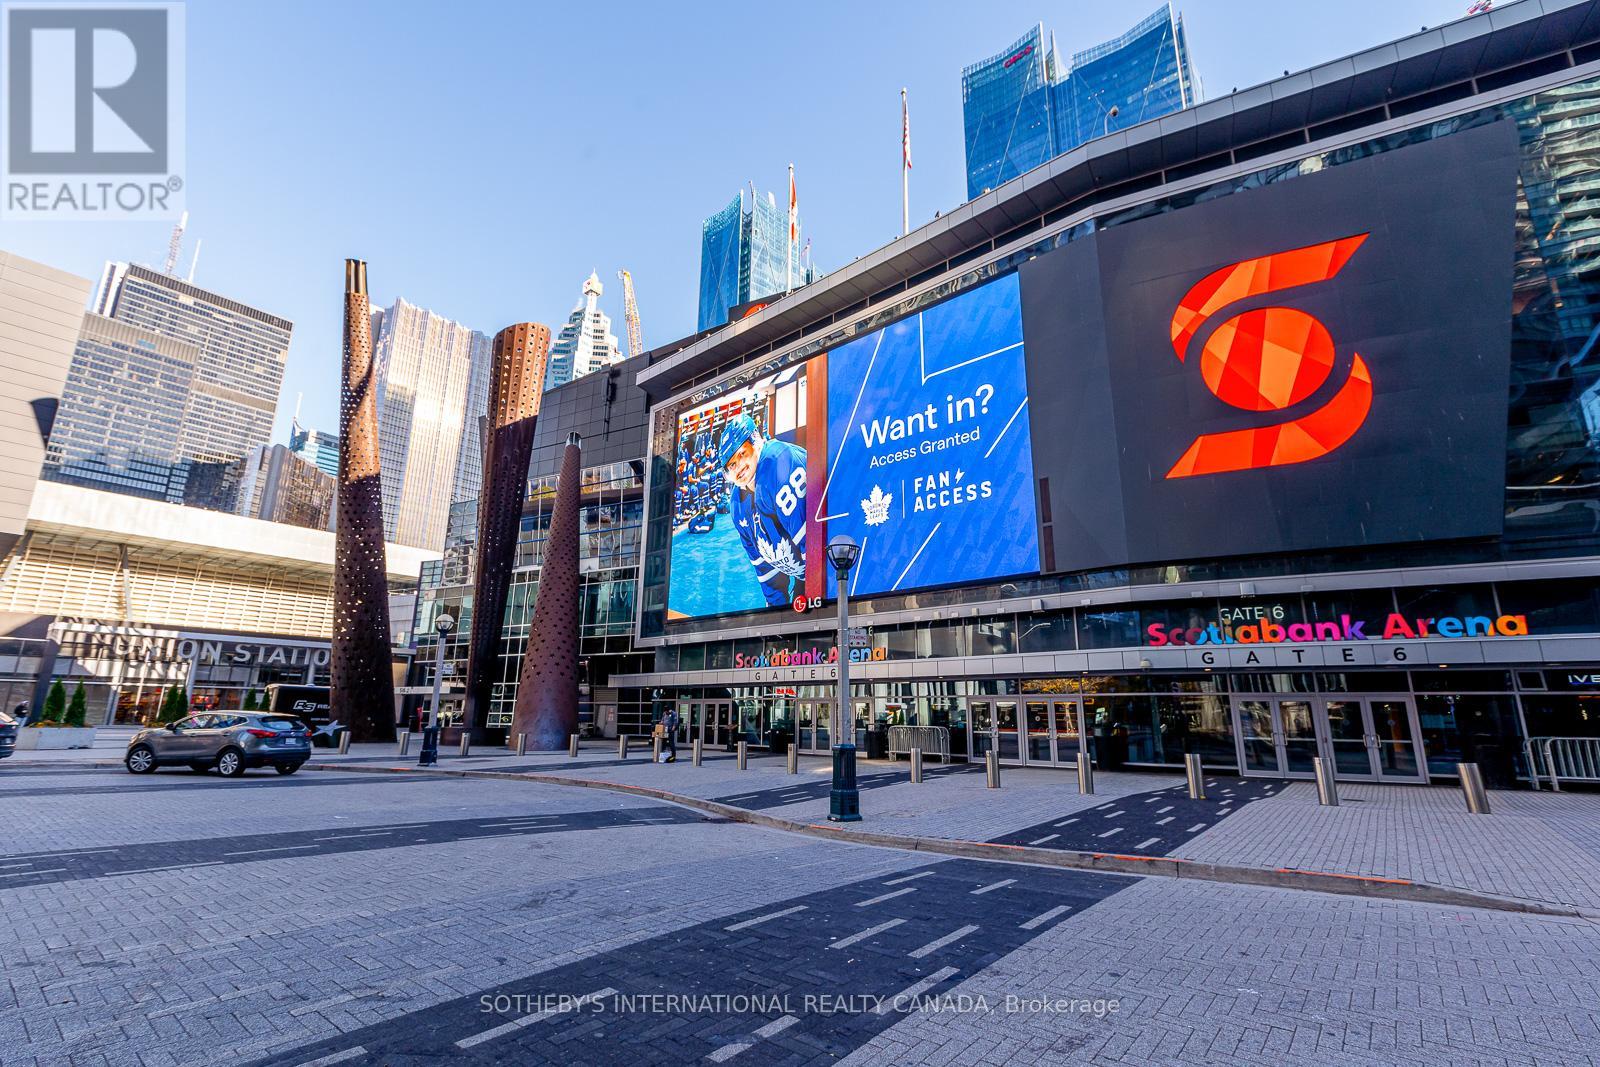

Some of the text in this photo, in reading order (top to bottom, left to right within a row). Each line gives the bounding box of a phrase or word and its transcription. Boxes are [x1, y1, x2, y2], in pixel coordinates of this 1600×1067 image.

[860, 383, 994, 448] Want in?
[869, 426, 980, 469] Access Granted
[775, 466, 807, 517] 88
[914, 470, 950, 494] FAN
[913, 480, 992, 513] ACCESS
[808, 596, 822, 609] LG
[1220, 604, 1285, 620] GATE 6
[1147, 612, 1529, 647] Scotiabank Arena
[114, 636, 330, 666] UNION STATIO
[735, 646, 886, 668] Scotiabank Aena
[1394, 646, 1407, 662] 6
[830, 668, 836, 678] 6
